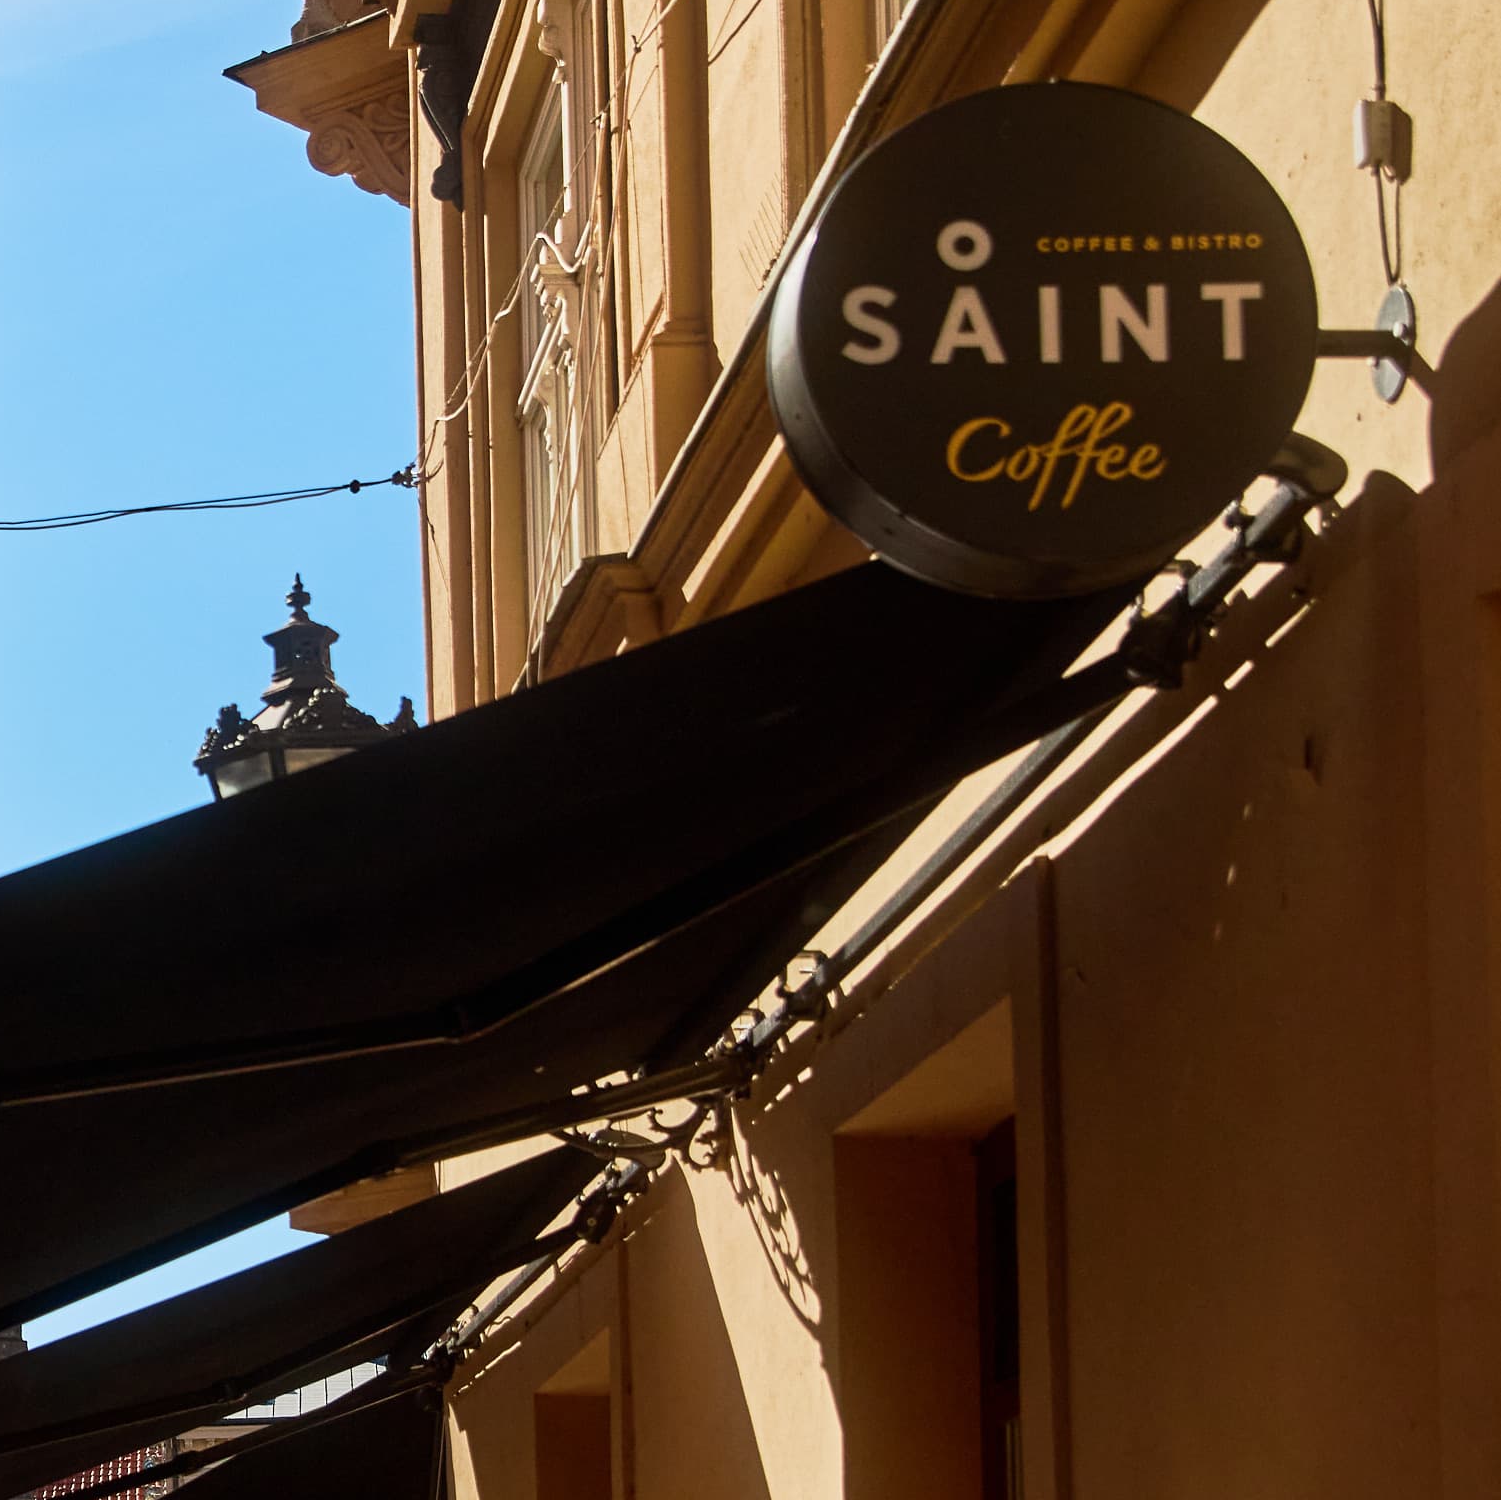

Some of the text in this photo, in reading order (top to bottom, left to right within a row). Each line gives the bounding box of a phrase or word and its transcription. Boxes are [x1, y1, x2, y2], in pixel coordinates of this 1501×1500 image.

[1036, 233, 1264, 253] COFFEE & BISTRO
[946, 402, 1169, 512] Coffee
